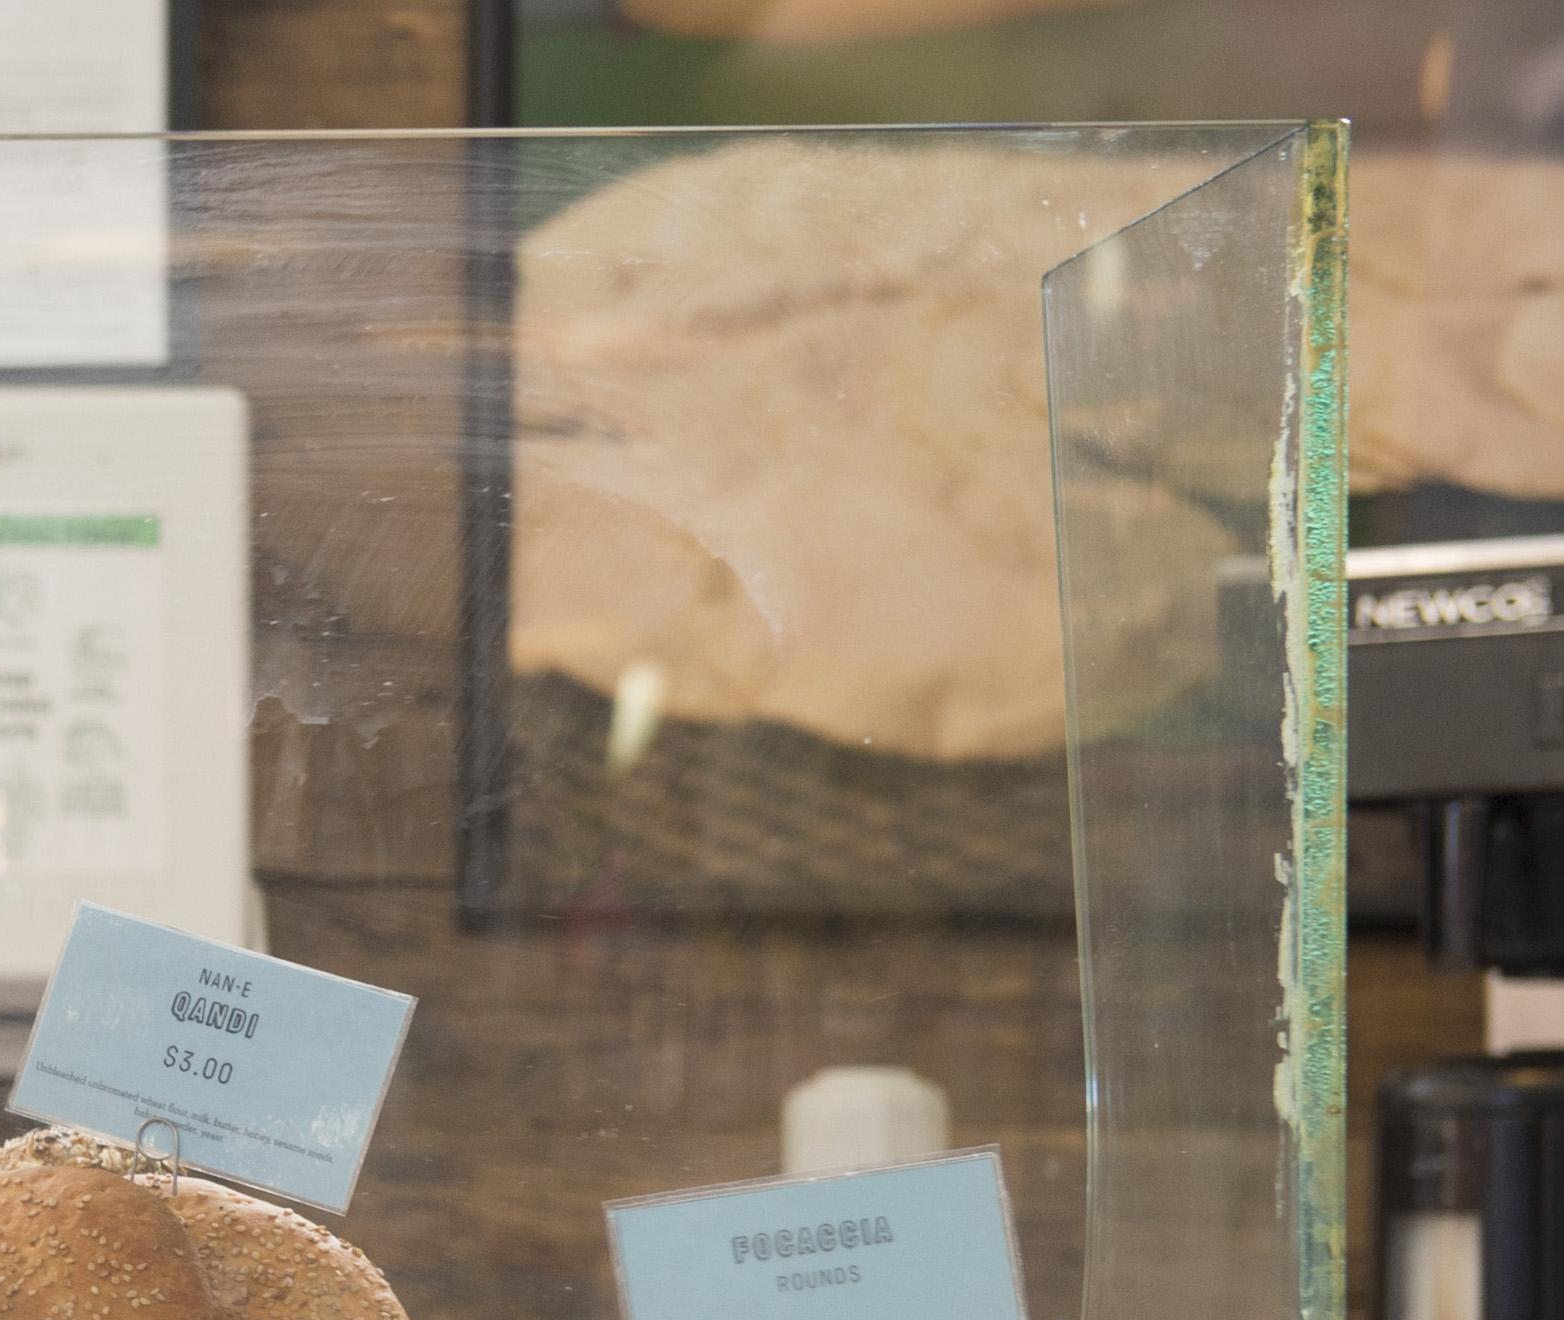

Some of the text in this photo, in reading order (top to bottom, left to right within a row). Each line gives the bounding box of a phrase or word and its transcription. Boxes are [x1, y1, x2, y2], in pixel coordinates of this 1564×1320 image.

[198, 967, 253, 998] NAN-E
[171, 990, 260, 1040] QANDI
[163, 1044, 234, 1086] $3.00
[731, 1215, 896, 1264] FOCACCIA
[776, 1264, 861, 1293] ROUNDS
